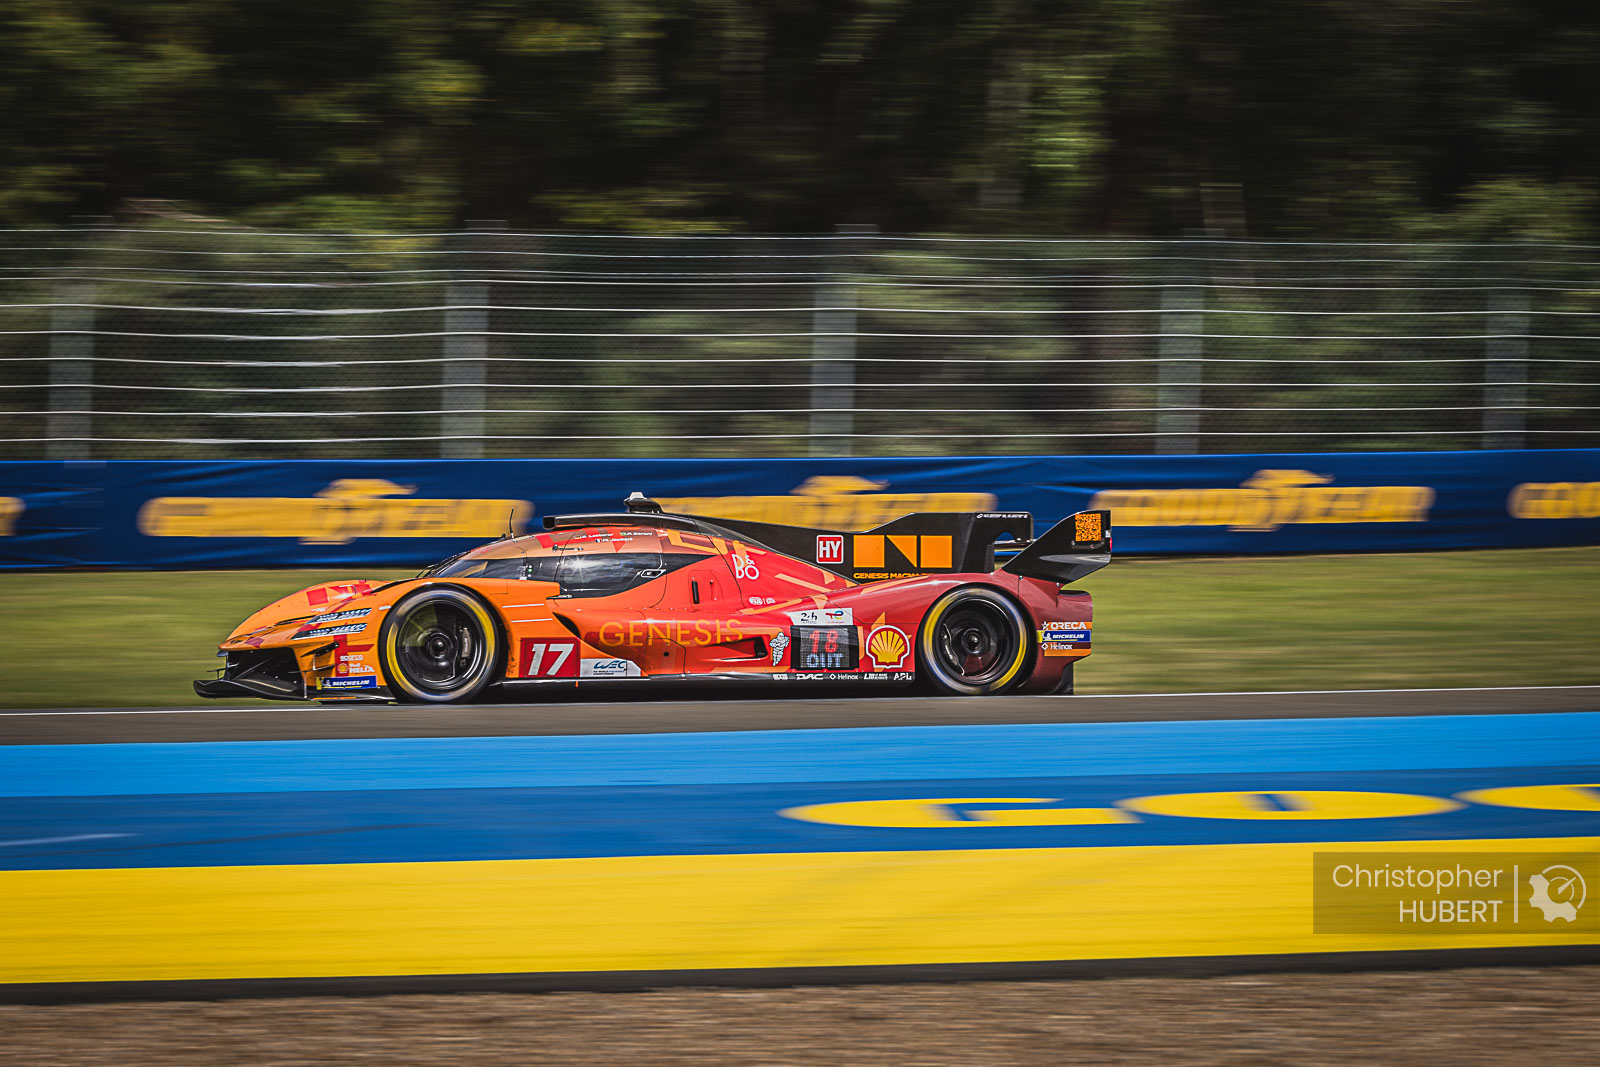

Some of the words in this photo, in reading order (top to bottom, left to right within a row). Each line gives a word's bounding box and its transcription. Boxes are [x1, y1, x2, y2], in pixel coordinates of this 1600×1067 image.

[819, 540, 841, 558] HY
[600, 619, 743, 647] GENESIS
[1050, 621, 1087, 630] ORECA
[809, 629, 839, 653] 18
[527, 643, 575, 676] 17
[593, 660, 627, 670] WEC
[806, 653, 844, 668] OUT
